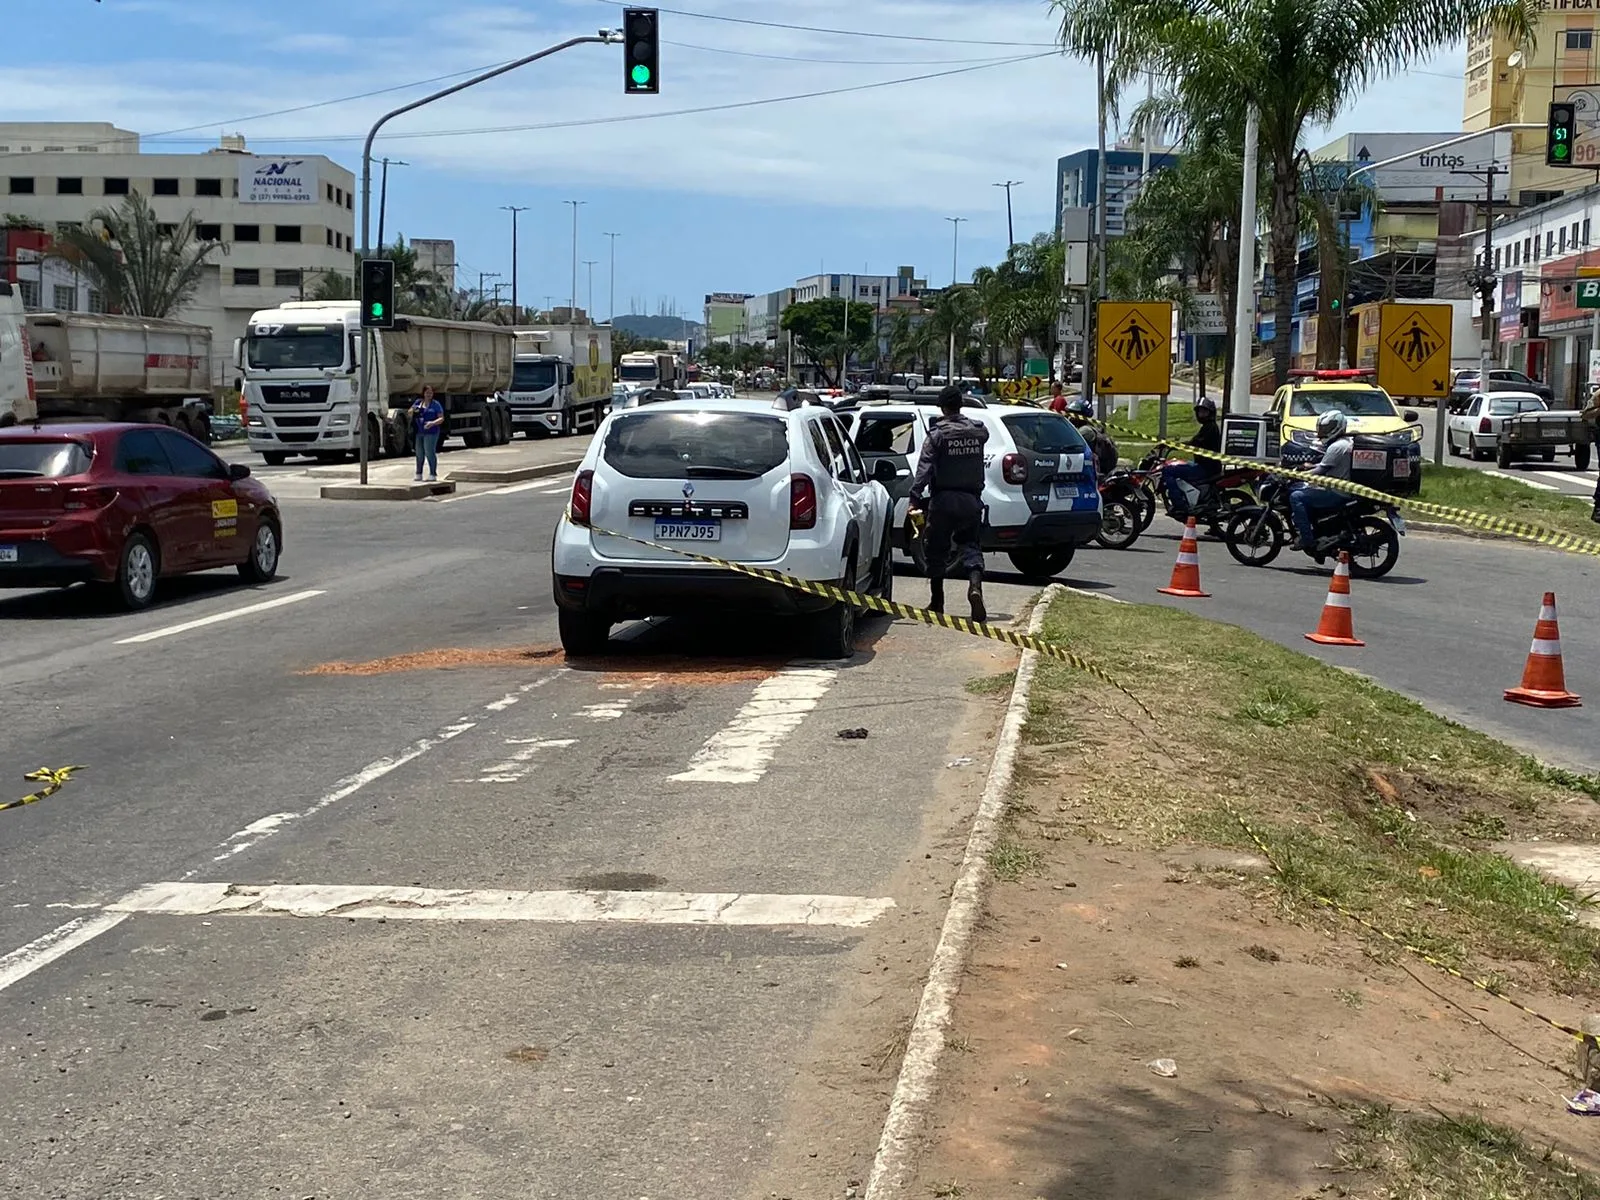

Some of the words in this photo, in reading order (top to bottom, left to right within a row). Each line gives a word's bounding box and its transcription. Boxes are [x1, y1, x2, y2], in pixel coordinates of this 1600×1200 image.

[1419, 152, 1464, 167] tintas
[253, 177, 302, 186] NACIONAL
[948, 446, 981, 456] MILITAR
[661, 525, 714, 539] PPN7J95
